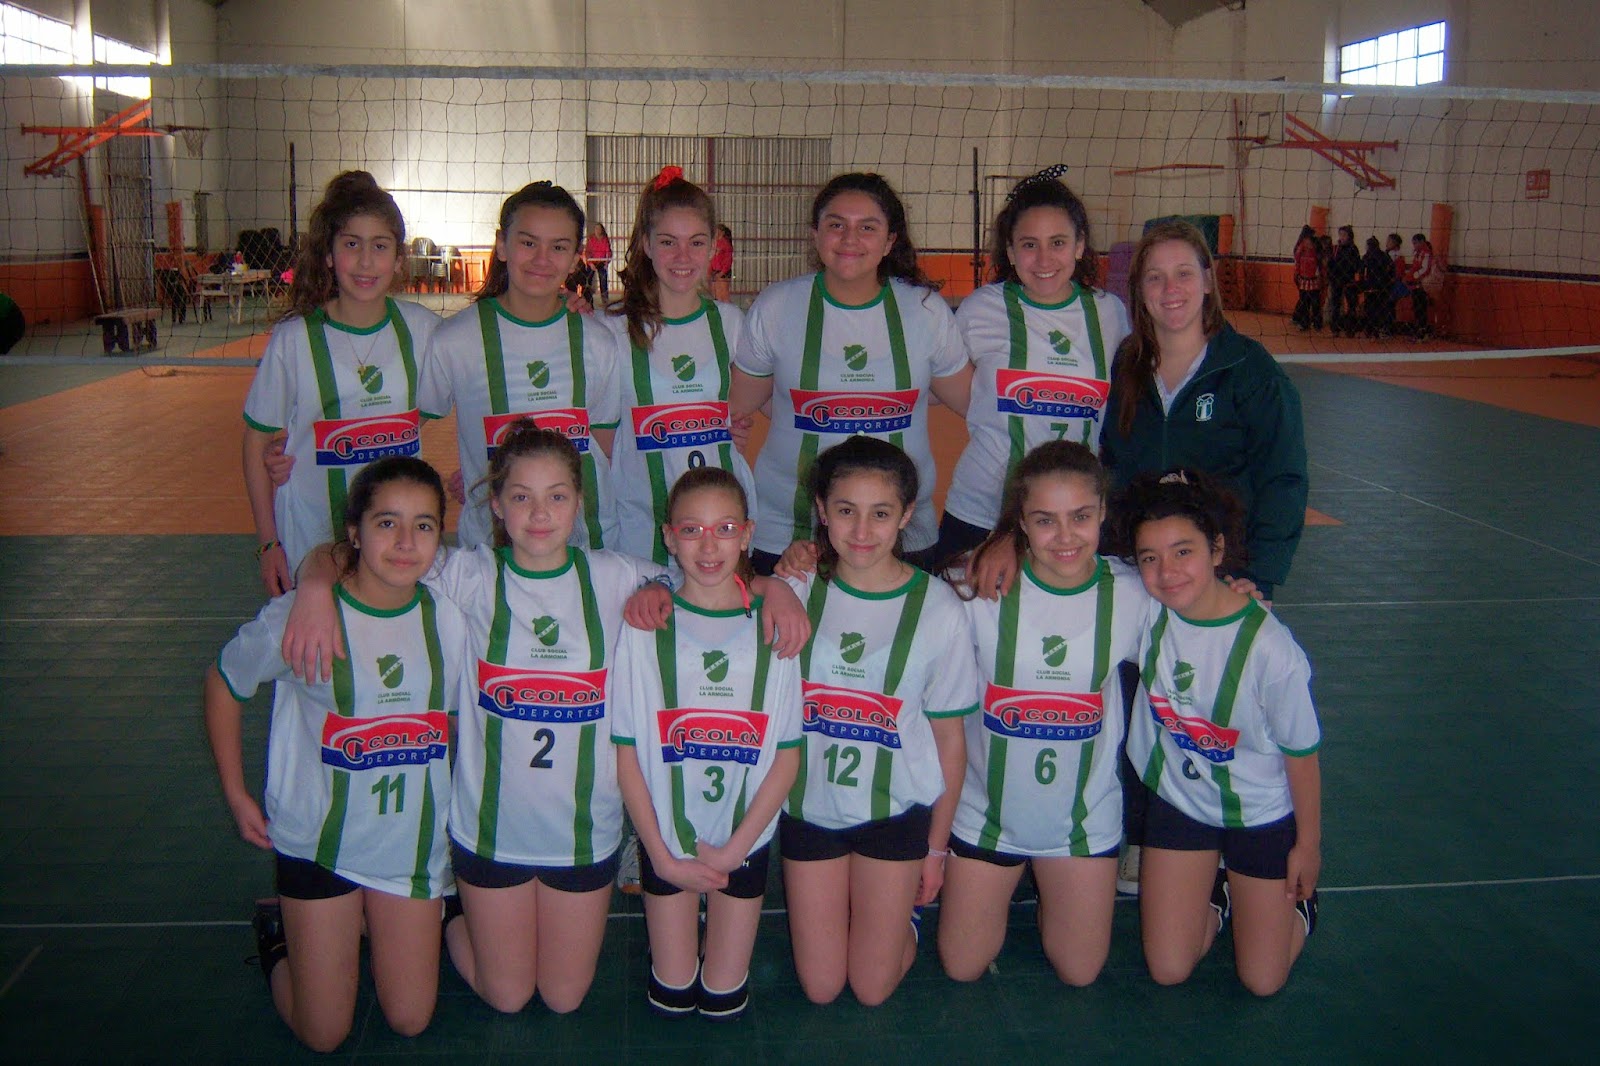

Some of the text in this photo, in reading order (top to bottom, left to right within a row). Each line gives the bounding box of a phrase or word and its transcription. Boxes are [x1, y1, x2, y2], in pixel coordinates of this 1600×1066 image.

[833, 404, 910, 417] COLON
[669, 416, 723, 431] COLO
[833, 418, 907, 430] DEPORTES
[1050, 422, 1069, 441] 7
[356, 426, 419, 446] COLON
[519, 687, 601, 704] COLON
[518, 707, 600, 718] DEPORTES
[821, 704, 898, 729] COLON
[1024, 708, 1103, 723] COLON
[368, 728, 443, 749] COLON
[689, 727, 761, 745] COLON
[822, 722, 899, 744] DEPORTES
[1024, 726, 1100, 737] DEPORTES
[529, 728, 556, 769] 2
[823, 743, 862, 787] 12
[1034, 747, 1058, 785] 6
[702, 765, 725, 803] 3
[371, 773, 406, 815] 11
